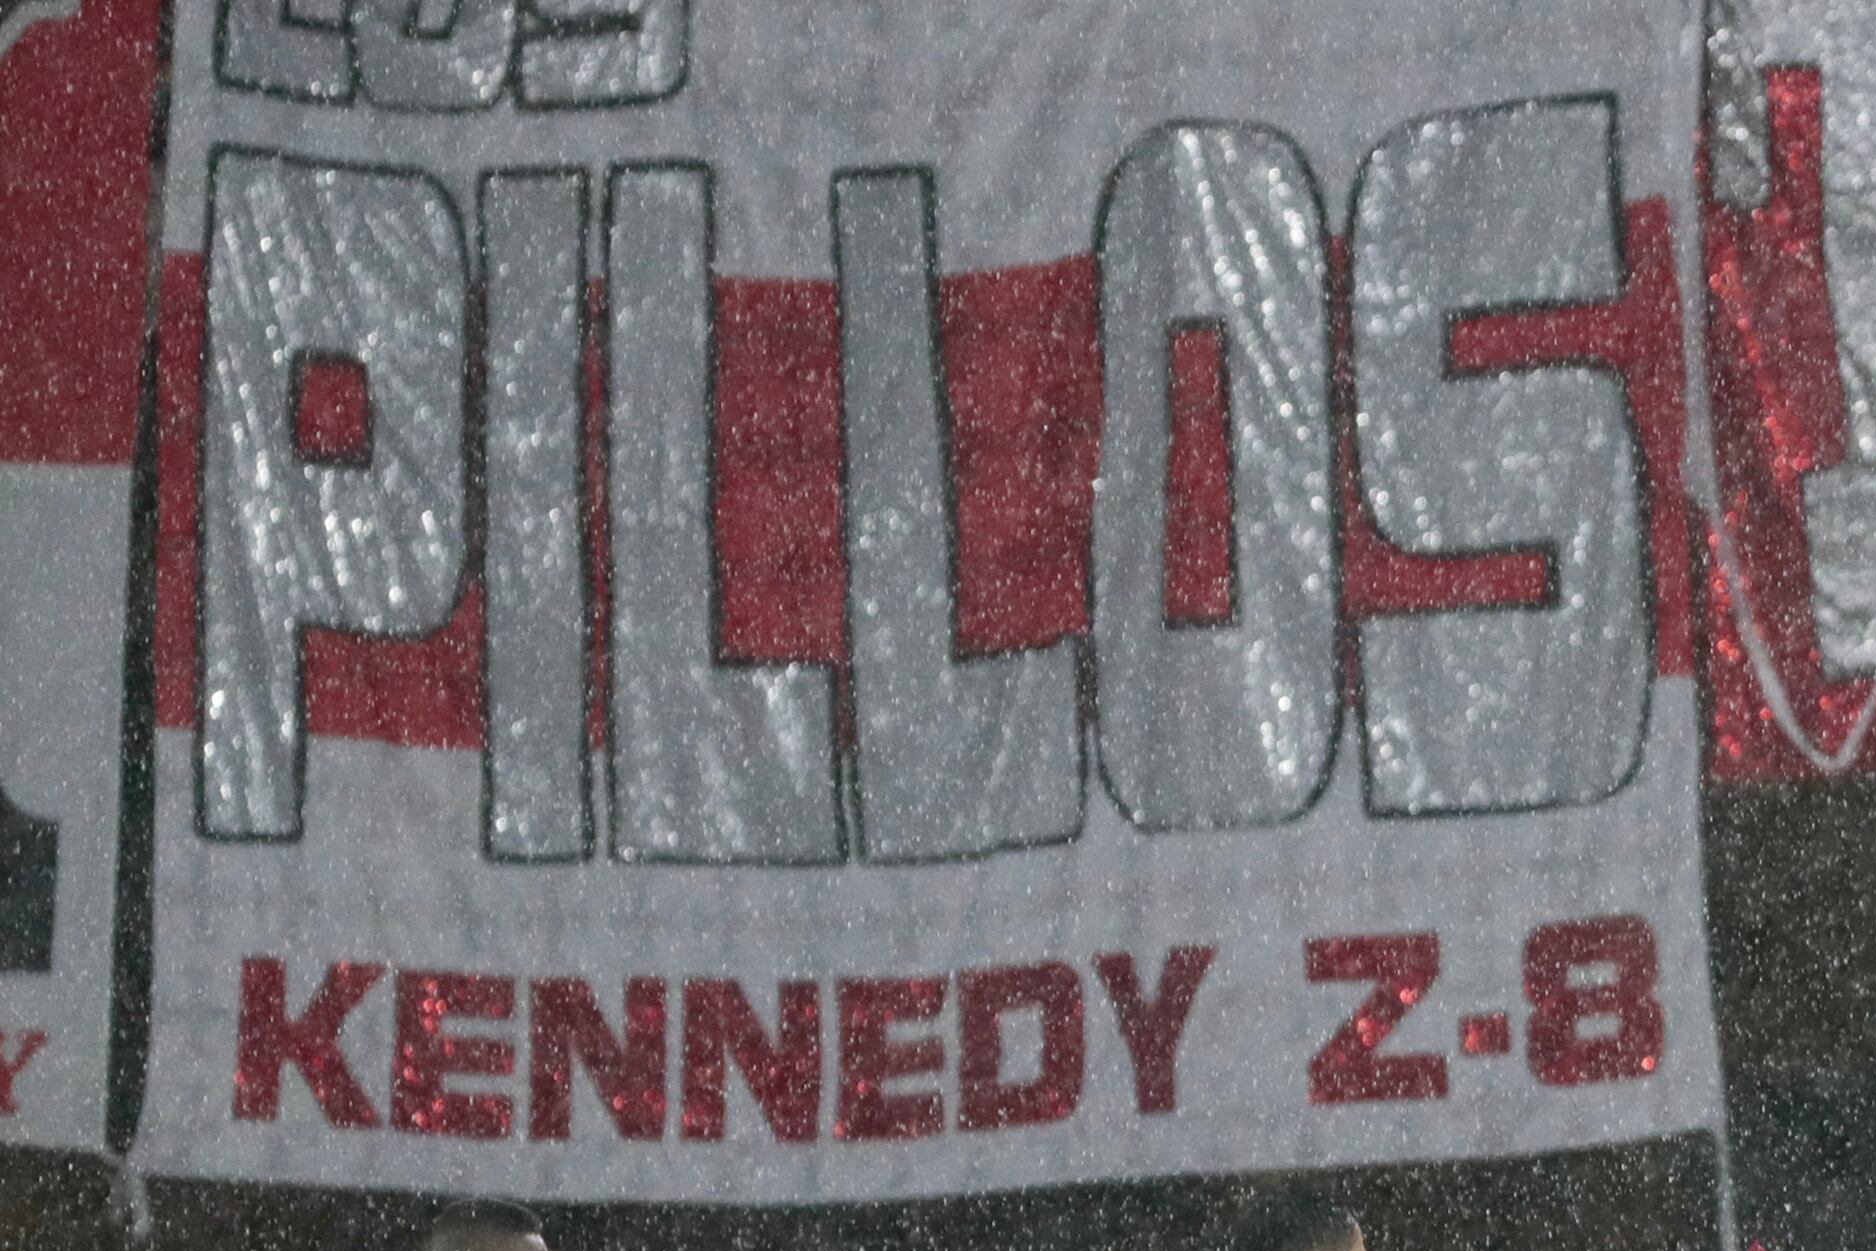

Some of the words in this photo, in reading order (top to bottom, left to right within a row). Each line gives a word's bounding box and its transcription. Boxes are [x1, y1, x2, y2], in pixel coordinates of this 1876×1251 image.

[197, 92, 1652, 865] PILLOS
[232, 945, 1219, 1143] KENNEDY
[1303, 914, 1664, 1105] Z-8
